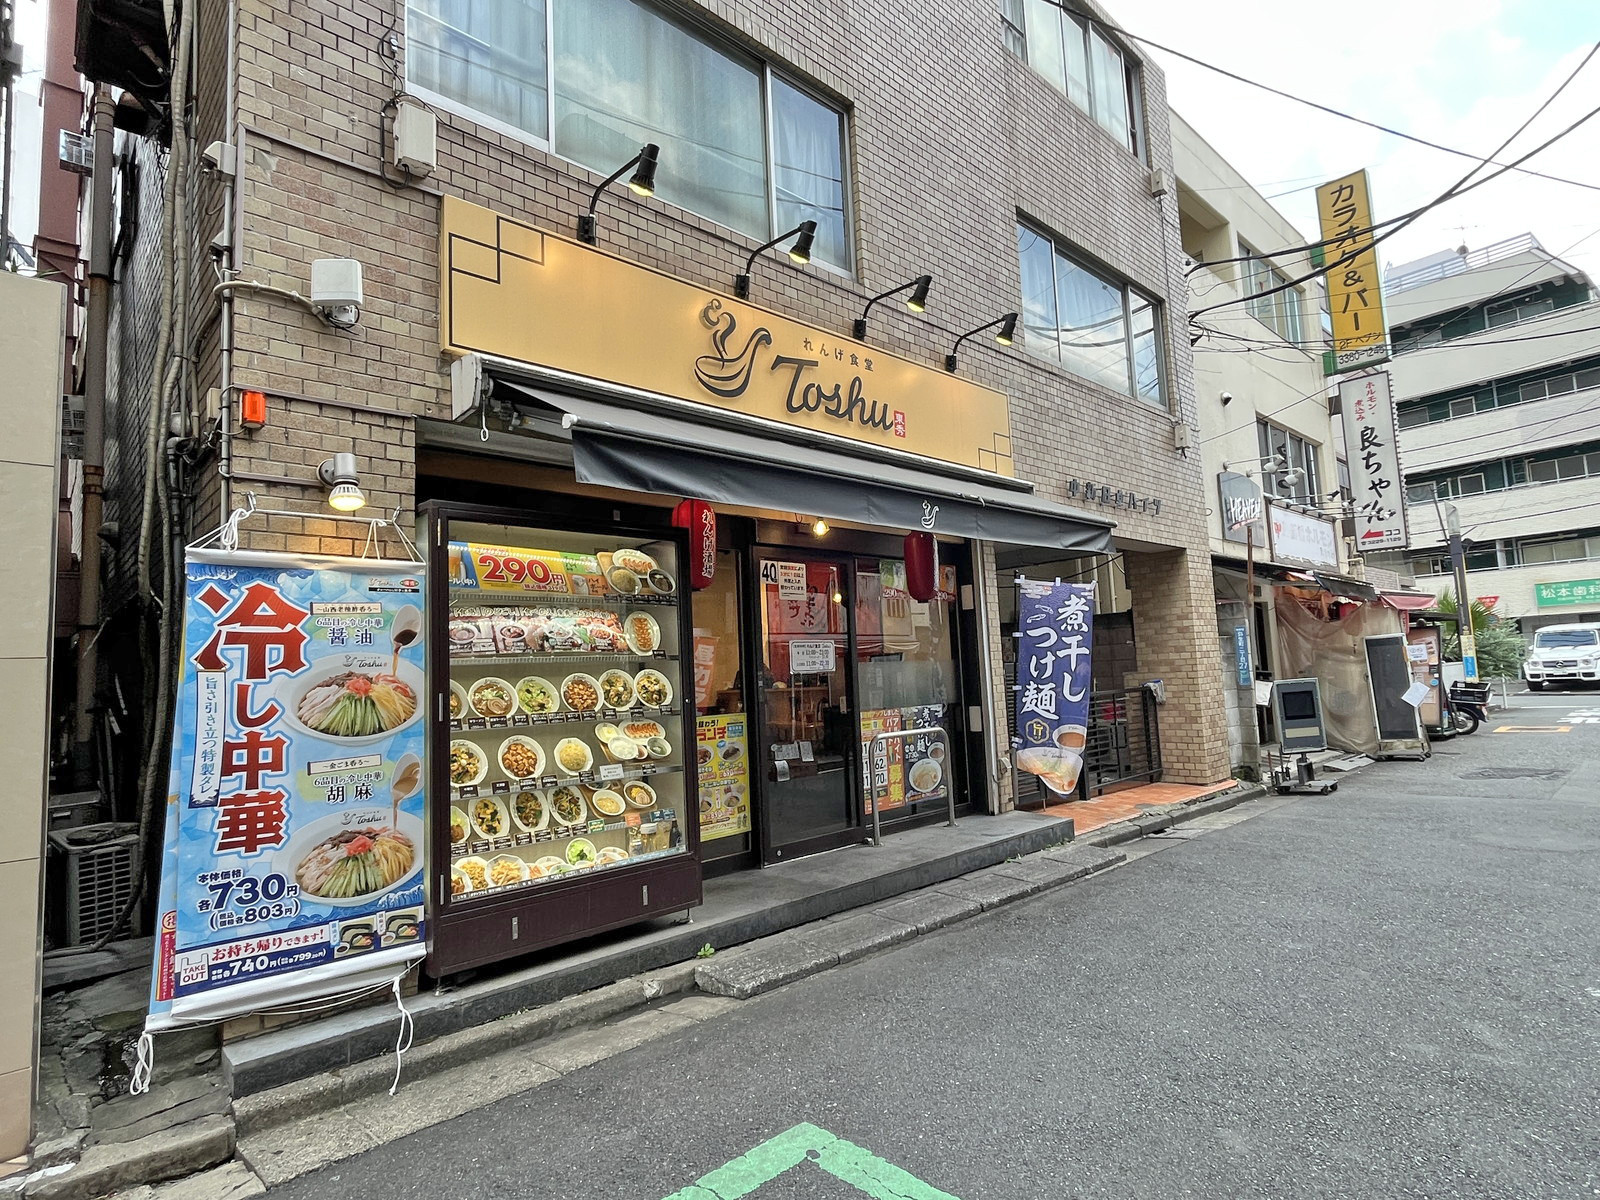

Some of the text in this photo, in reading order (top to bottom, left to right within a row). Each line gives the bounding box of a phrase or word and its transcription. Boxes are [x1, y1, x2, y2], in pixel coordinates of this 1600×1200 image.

[803, 337, 874, 372] れんげ食堂
[771, 354, 894, 431] Toshu
[895, 411, 906, 438] 東秀
[1360, 426, 1392, 524] 良ちゃん
[1229, 495, 1261, 524] HEAVEN
[1385, 529, 1401, 537] ココ
[762, 562, 777, 582] 40
[328, 627, 373, 646] 醤油
[1056, 594, 1090, 703] 煮干し
[358, 659, 383, 668] Toshu
[1020, 625, 1060, 720] つけ麺
[193, 583, 311, 854] 冷し中華
[198, 676, 218, 794] 旨さ引き立つ特製タレ
[326, 783, 373, 803] 胡麻
[355, 815, 382, 825] Toshu
[198, 869, 242, 883] 本体価格
[182, 972, 207, 983] OUT
[183, 964, 206, 974] TAKE
